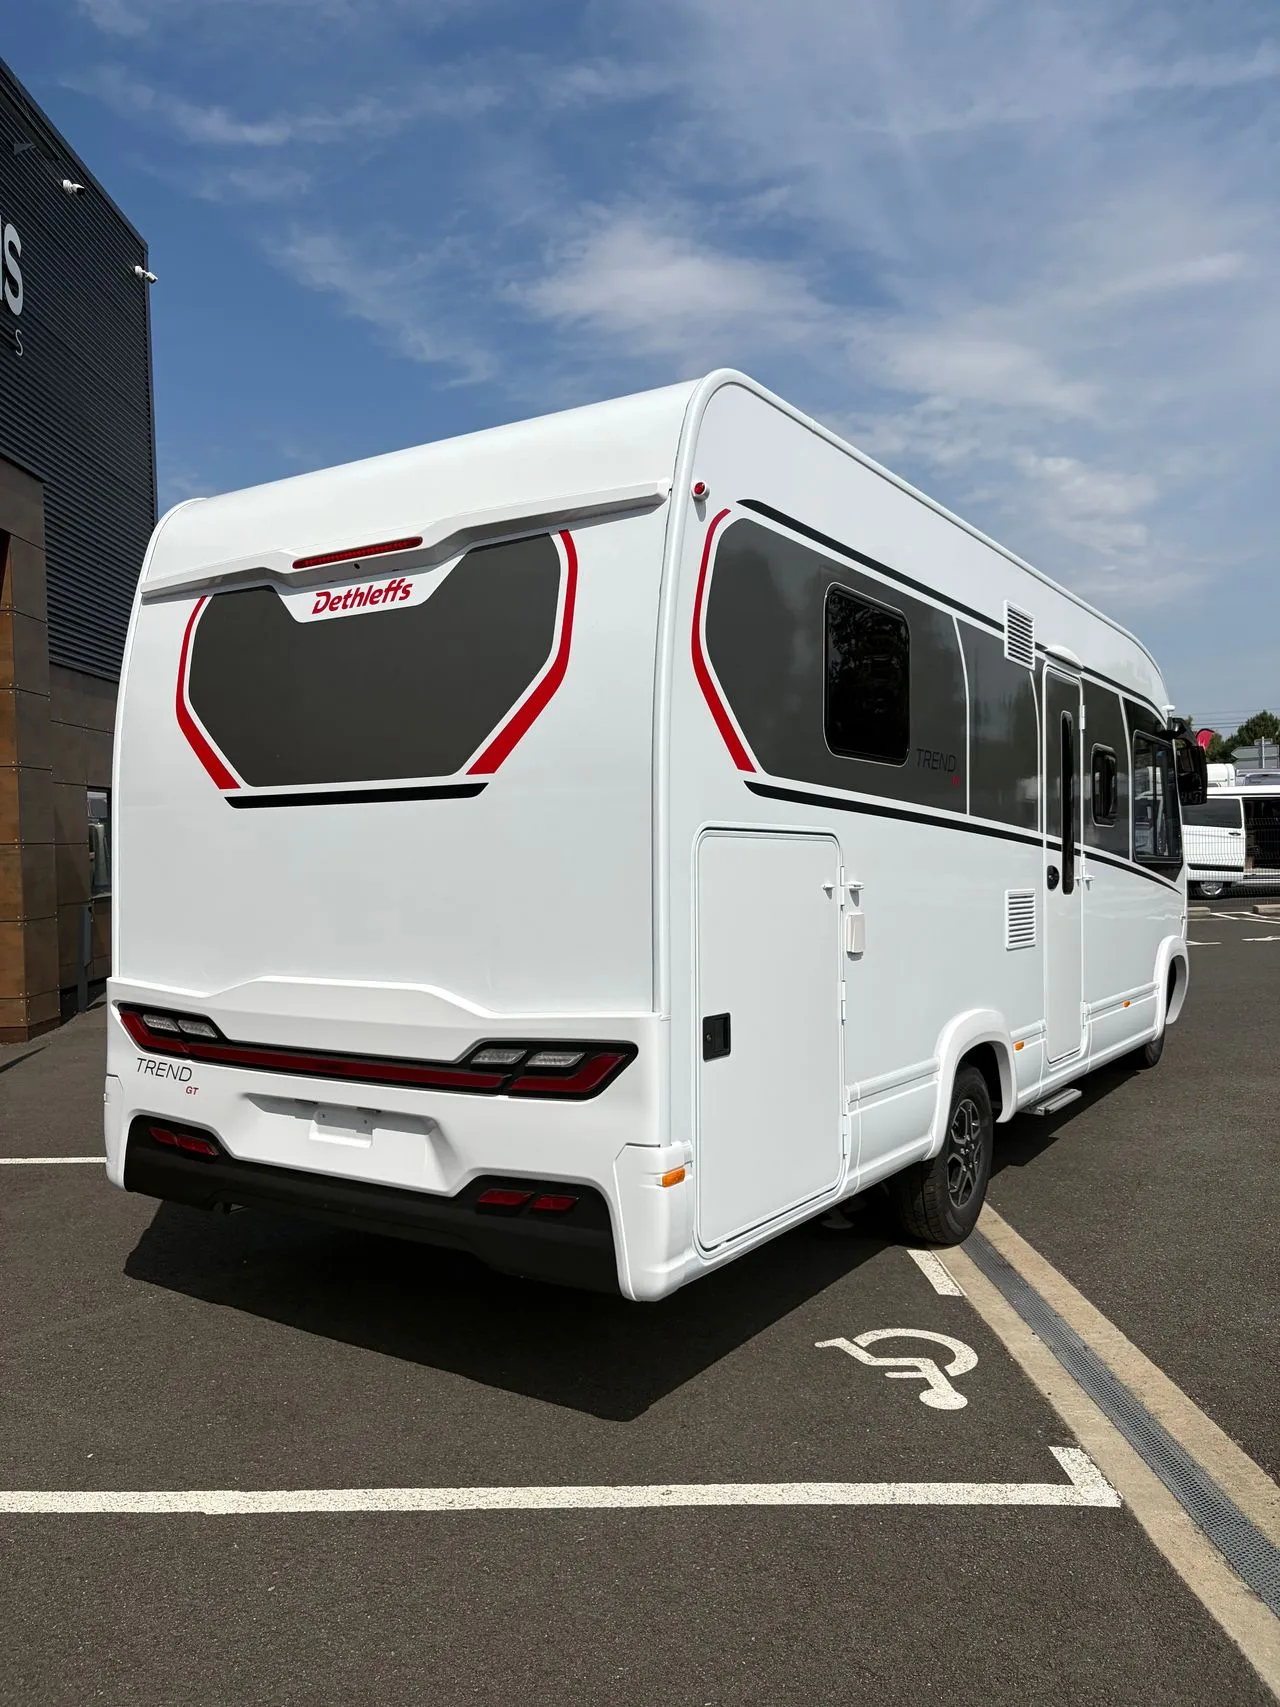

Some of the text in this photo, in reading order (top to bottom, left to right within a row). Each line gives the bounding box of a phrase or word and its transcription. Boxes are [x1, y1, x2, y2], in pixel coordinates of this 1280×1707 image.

[312, 577, 413, 615] Dethleffs
[916, 748, 956, 773] TREND
[136, 1057, 193, 1082] TREND
[185, 1085, 199, 1096] GT
